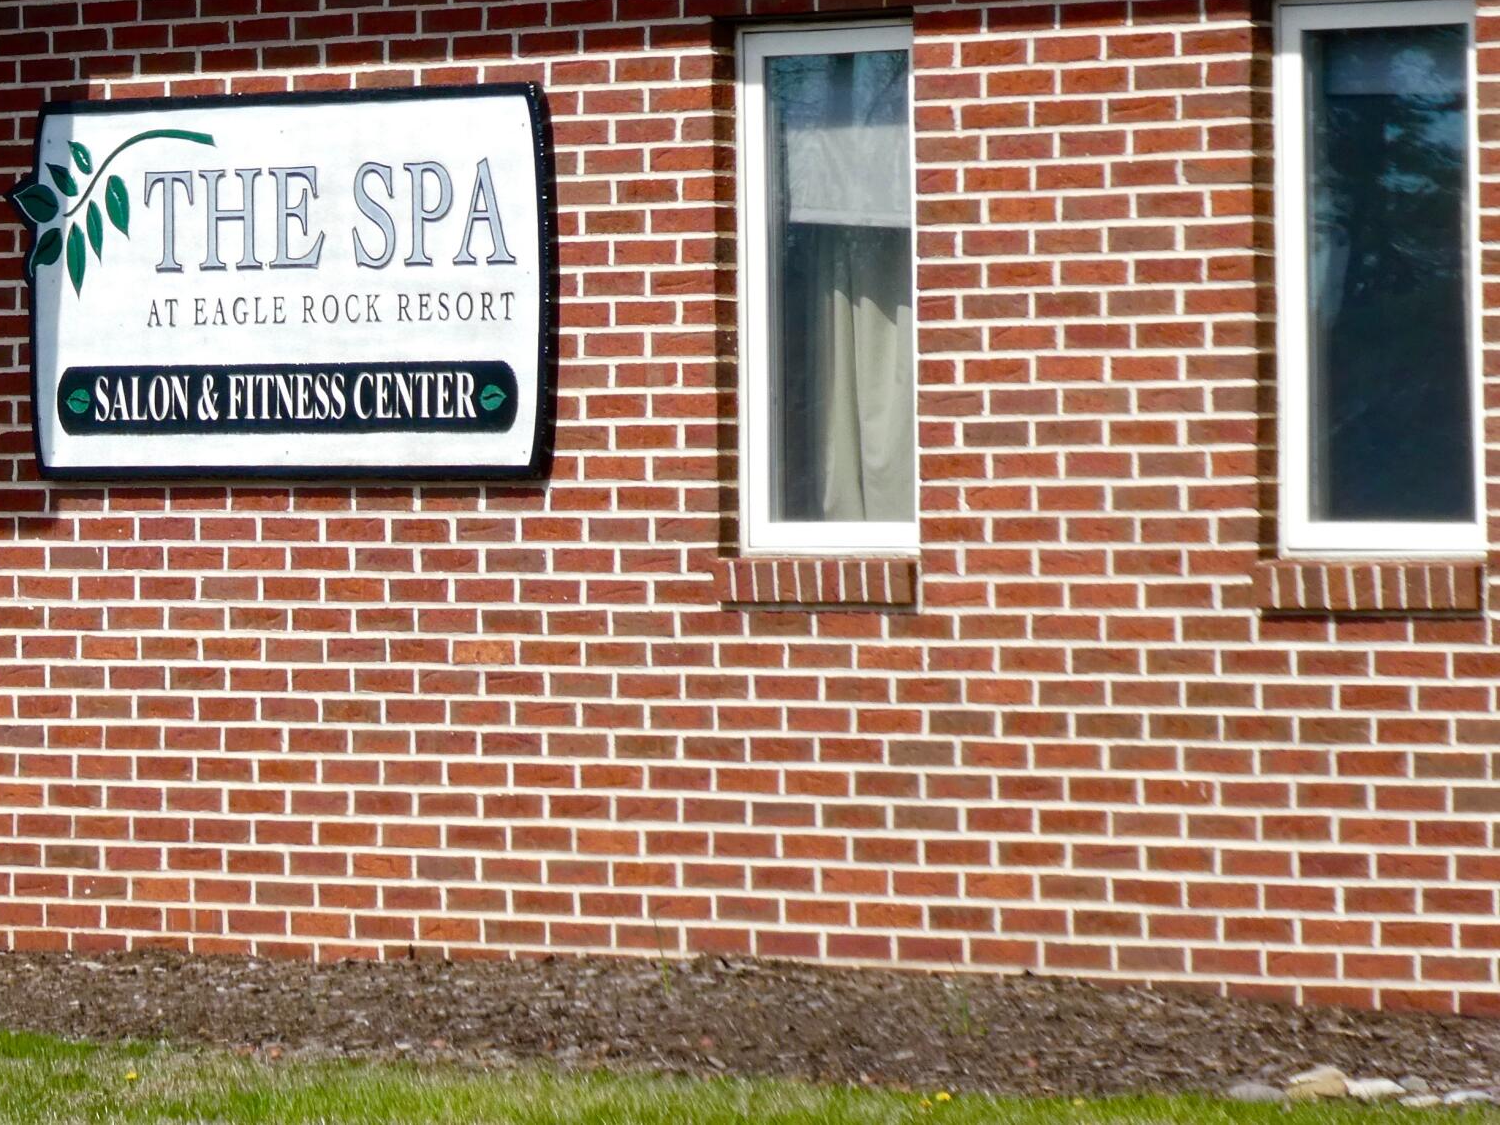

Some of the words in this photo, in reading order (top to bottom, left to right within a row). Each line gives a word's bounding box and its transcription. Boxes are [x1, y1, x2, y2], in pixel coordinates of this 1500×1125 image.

[144, 166, 325, 273] THE
[351, 157, 517, 269] SPA
[147, 299, 179, 328] AT
[194, 296, 288, 326] EAGLE
[302, 294, 383, 324] ROCK
[397, 291, 516, 322] RESORT
[94, 375, 190, 422] SALON
[197, 376, 220, 421] &
[229, 371, 346, 422] FITNESS
[353, 371, 478, 421] CENTER
